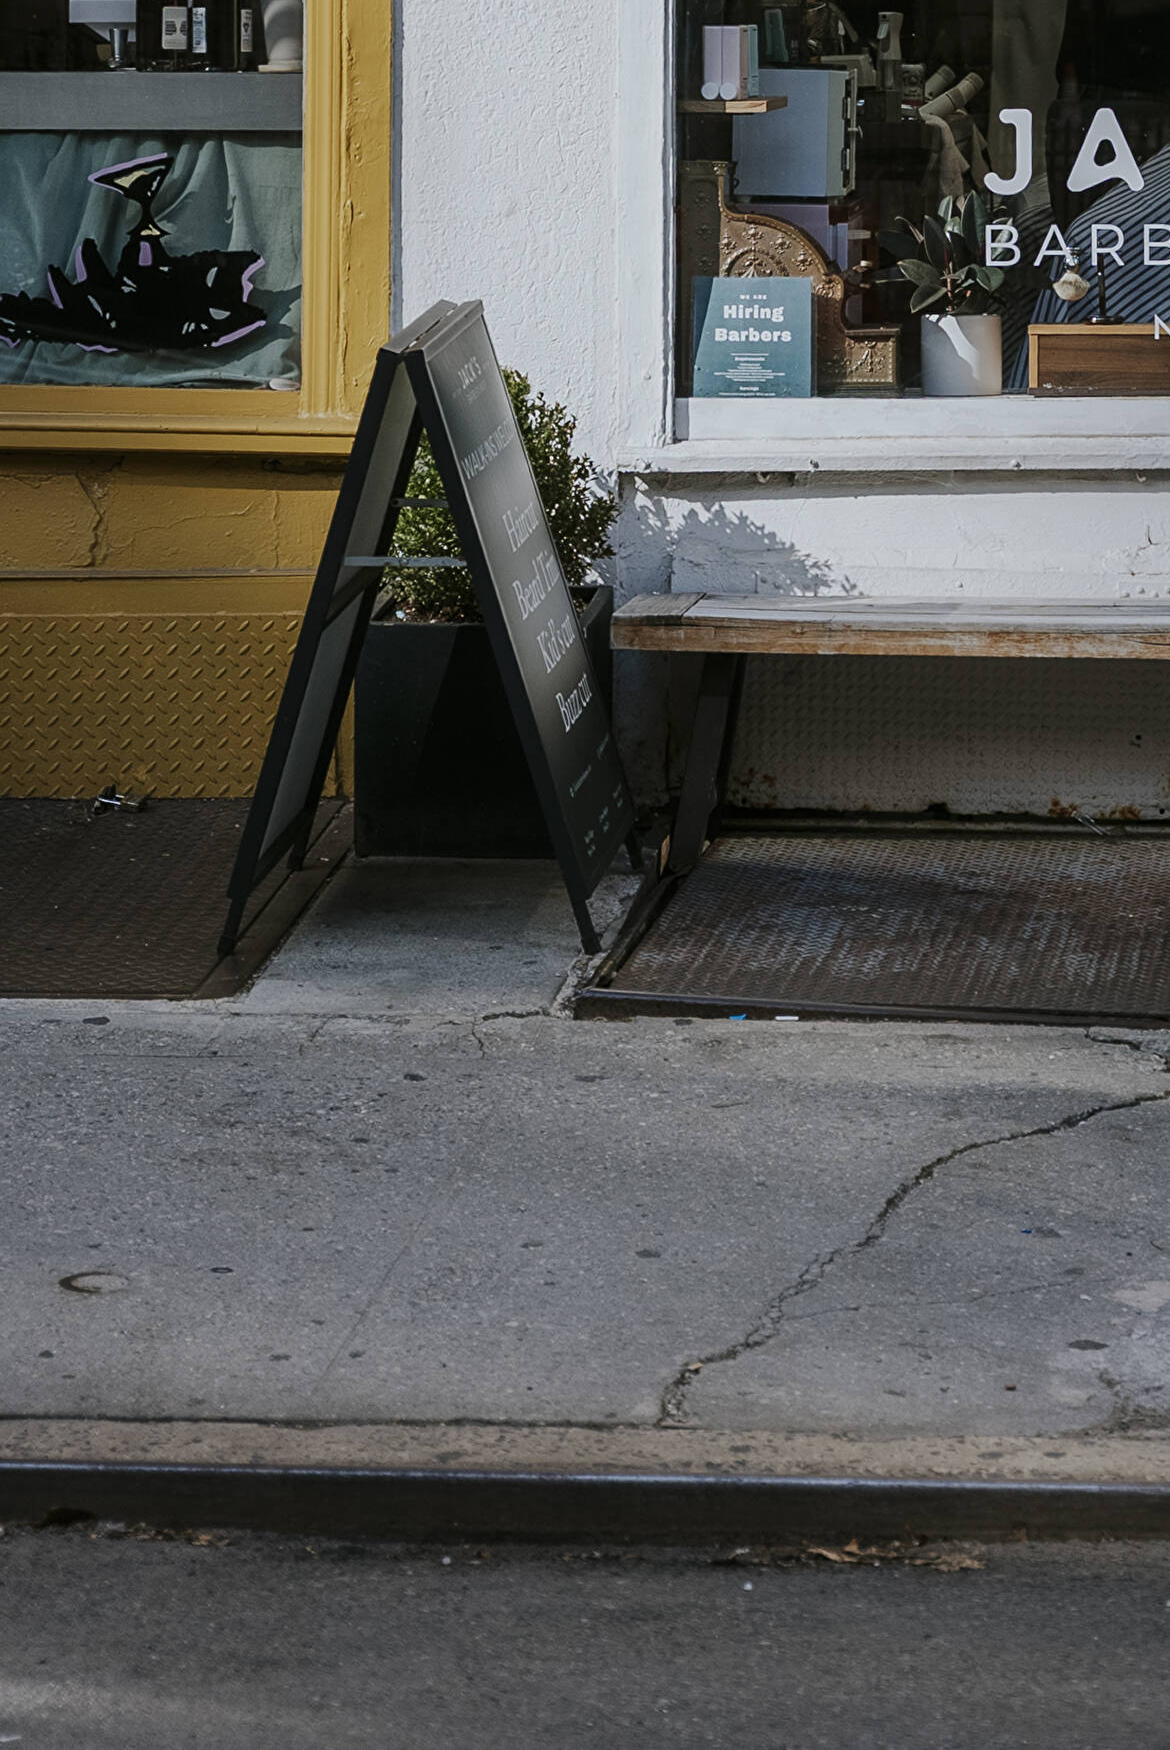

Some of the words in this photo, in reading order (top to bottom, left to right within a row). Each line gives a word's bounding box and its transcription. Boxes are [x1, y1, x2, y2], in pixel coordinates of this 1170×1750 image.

[714, 328, 792, 343] Barbers
[723, 304, 784, 323] Hiring
[502, 501, 539, 554] Haircut
[512, 559, 543, 621] Beard
[536, 617, 566, 674] Kid's
[561, 615, 576, 649] cut
[555, 688, 582, 733] Buzz
[578, 673, 593, 709] cut
